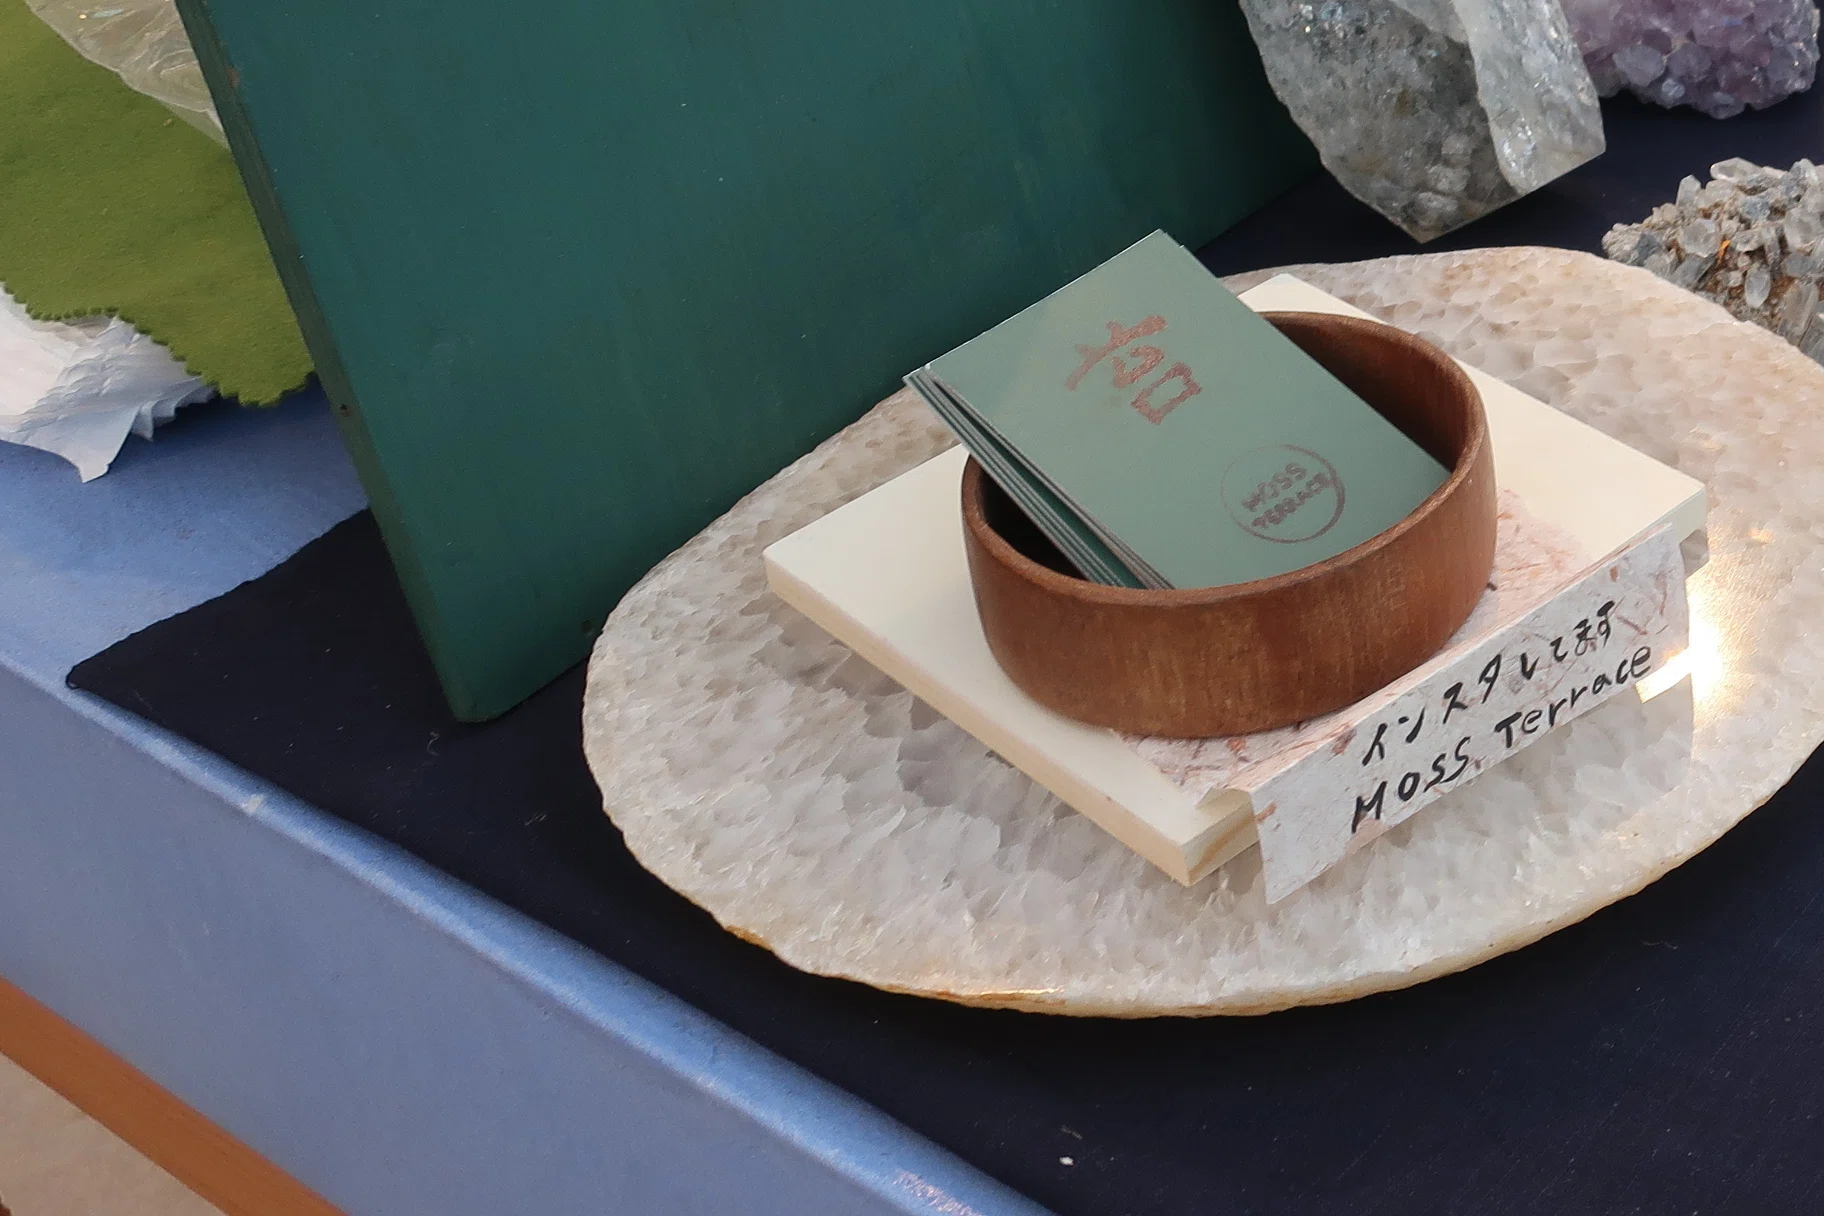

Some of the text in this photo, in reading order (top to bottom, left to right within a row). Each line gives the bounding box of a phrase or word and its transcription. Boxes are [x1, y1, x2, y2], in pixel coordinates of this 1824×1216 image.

[1066, 314, 1203, 425] 苔
[1241, 462, 1307, 513] MOSS
[1351, 645, 1652, 834] MOSS Terrace
[1361, 600, 1616, 766] インスタしてます
